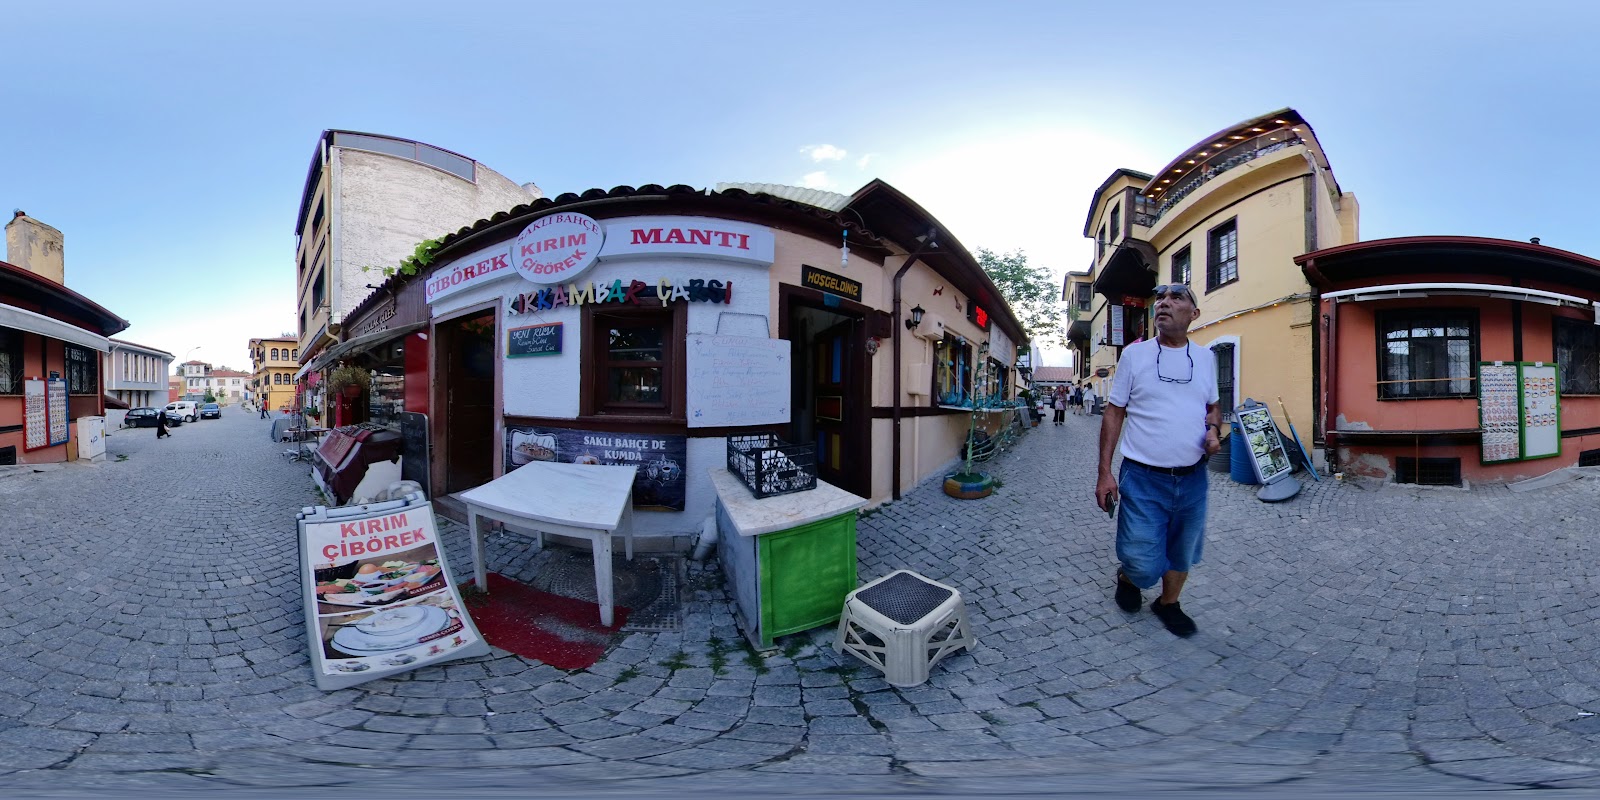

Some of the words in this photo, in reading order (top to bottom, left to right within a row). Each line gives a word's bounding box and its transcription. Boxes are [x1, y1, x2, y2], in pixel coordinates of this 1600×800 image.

[517, 216, 553, 245] SAKLI
[555, 214, 599, 236] BAHÇE
[630, 228, 750, 250] MANTI
[520, 232, 587, 258] KIRIM
[519, 248, 587, 275] ÇİBÖREK
[426, 253, 508, 300] ÇİBÖREK
[506, 279, 647, 317] KIRKAMBAR
[583, 436, 612, 447] SAKLI
[615, 437, 649, 451] BAHÇE
[651, 440, 666, 450] DE
[604, 449, 643, 461] KUMDA
[340, 513, 409, 538] KIRIM
[322, 527, 427, 561] ÇİBÖREK
